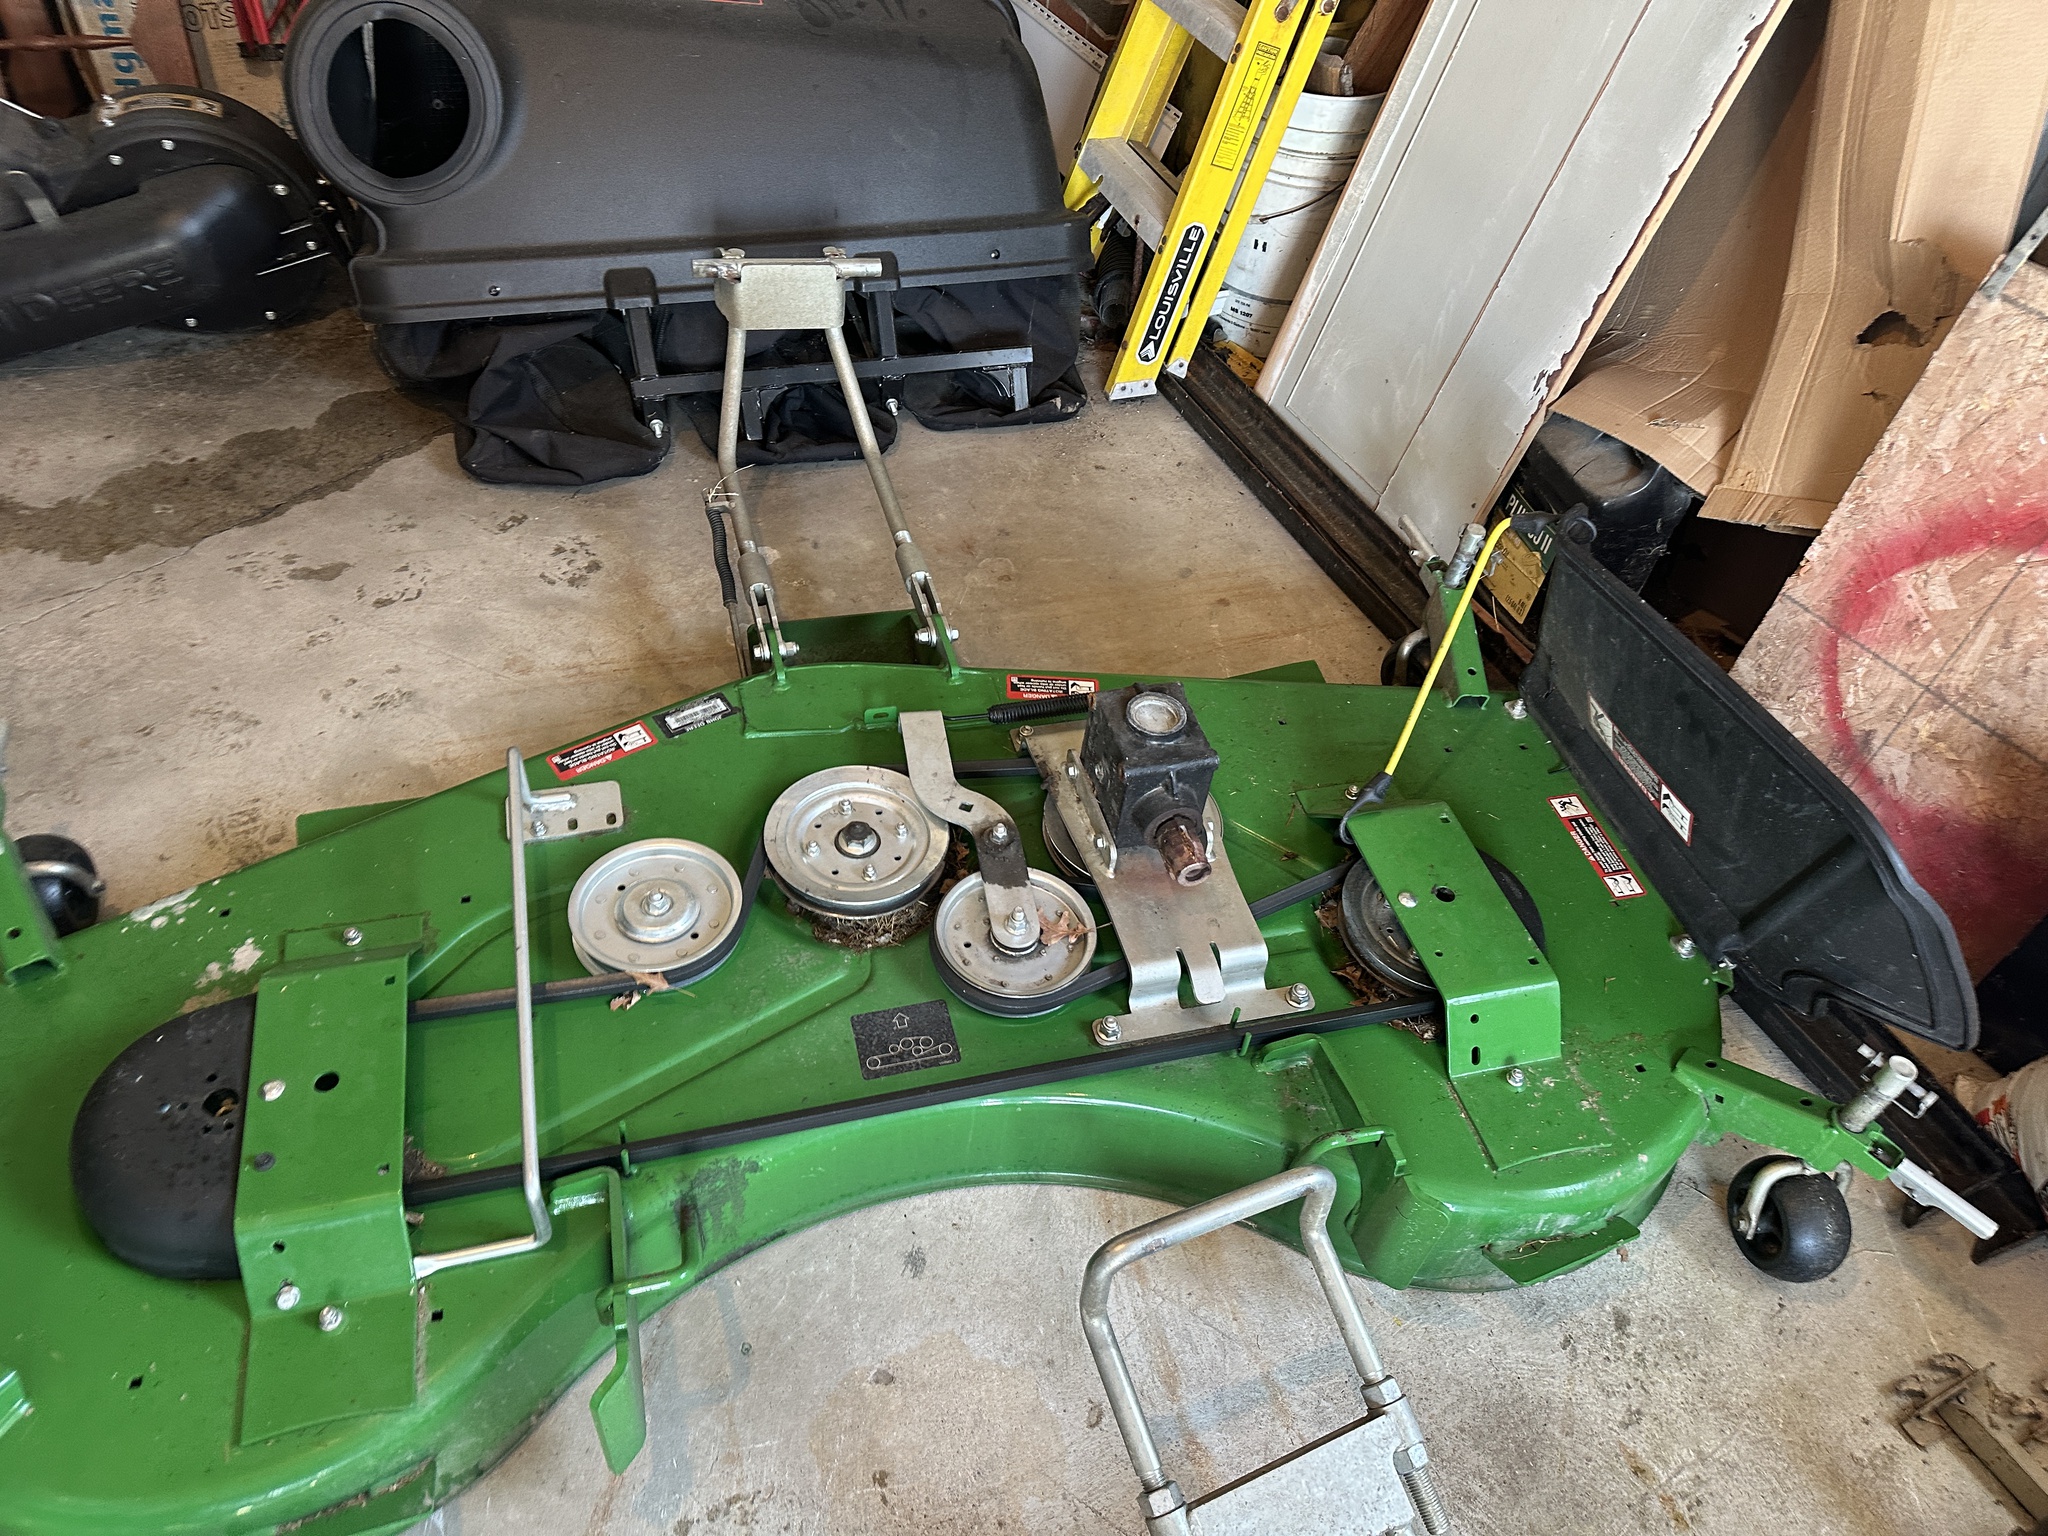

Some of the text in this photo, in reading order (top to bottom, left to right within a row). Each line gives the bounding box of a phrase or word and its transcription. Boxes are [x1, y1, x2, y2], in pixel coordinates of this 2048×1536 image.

[12, 257, 184, 322] DEERE
[1148, 226, 1202, 341] LOUISVILLE
[576, 758, 606, 773] DANGER
[1569, 830, 1592, 856] DANGER
